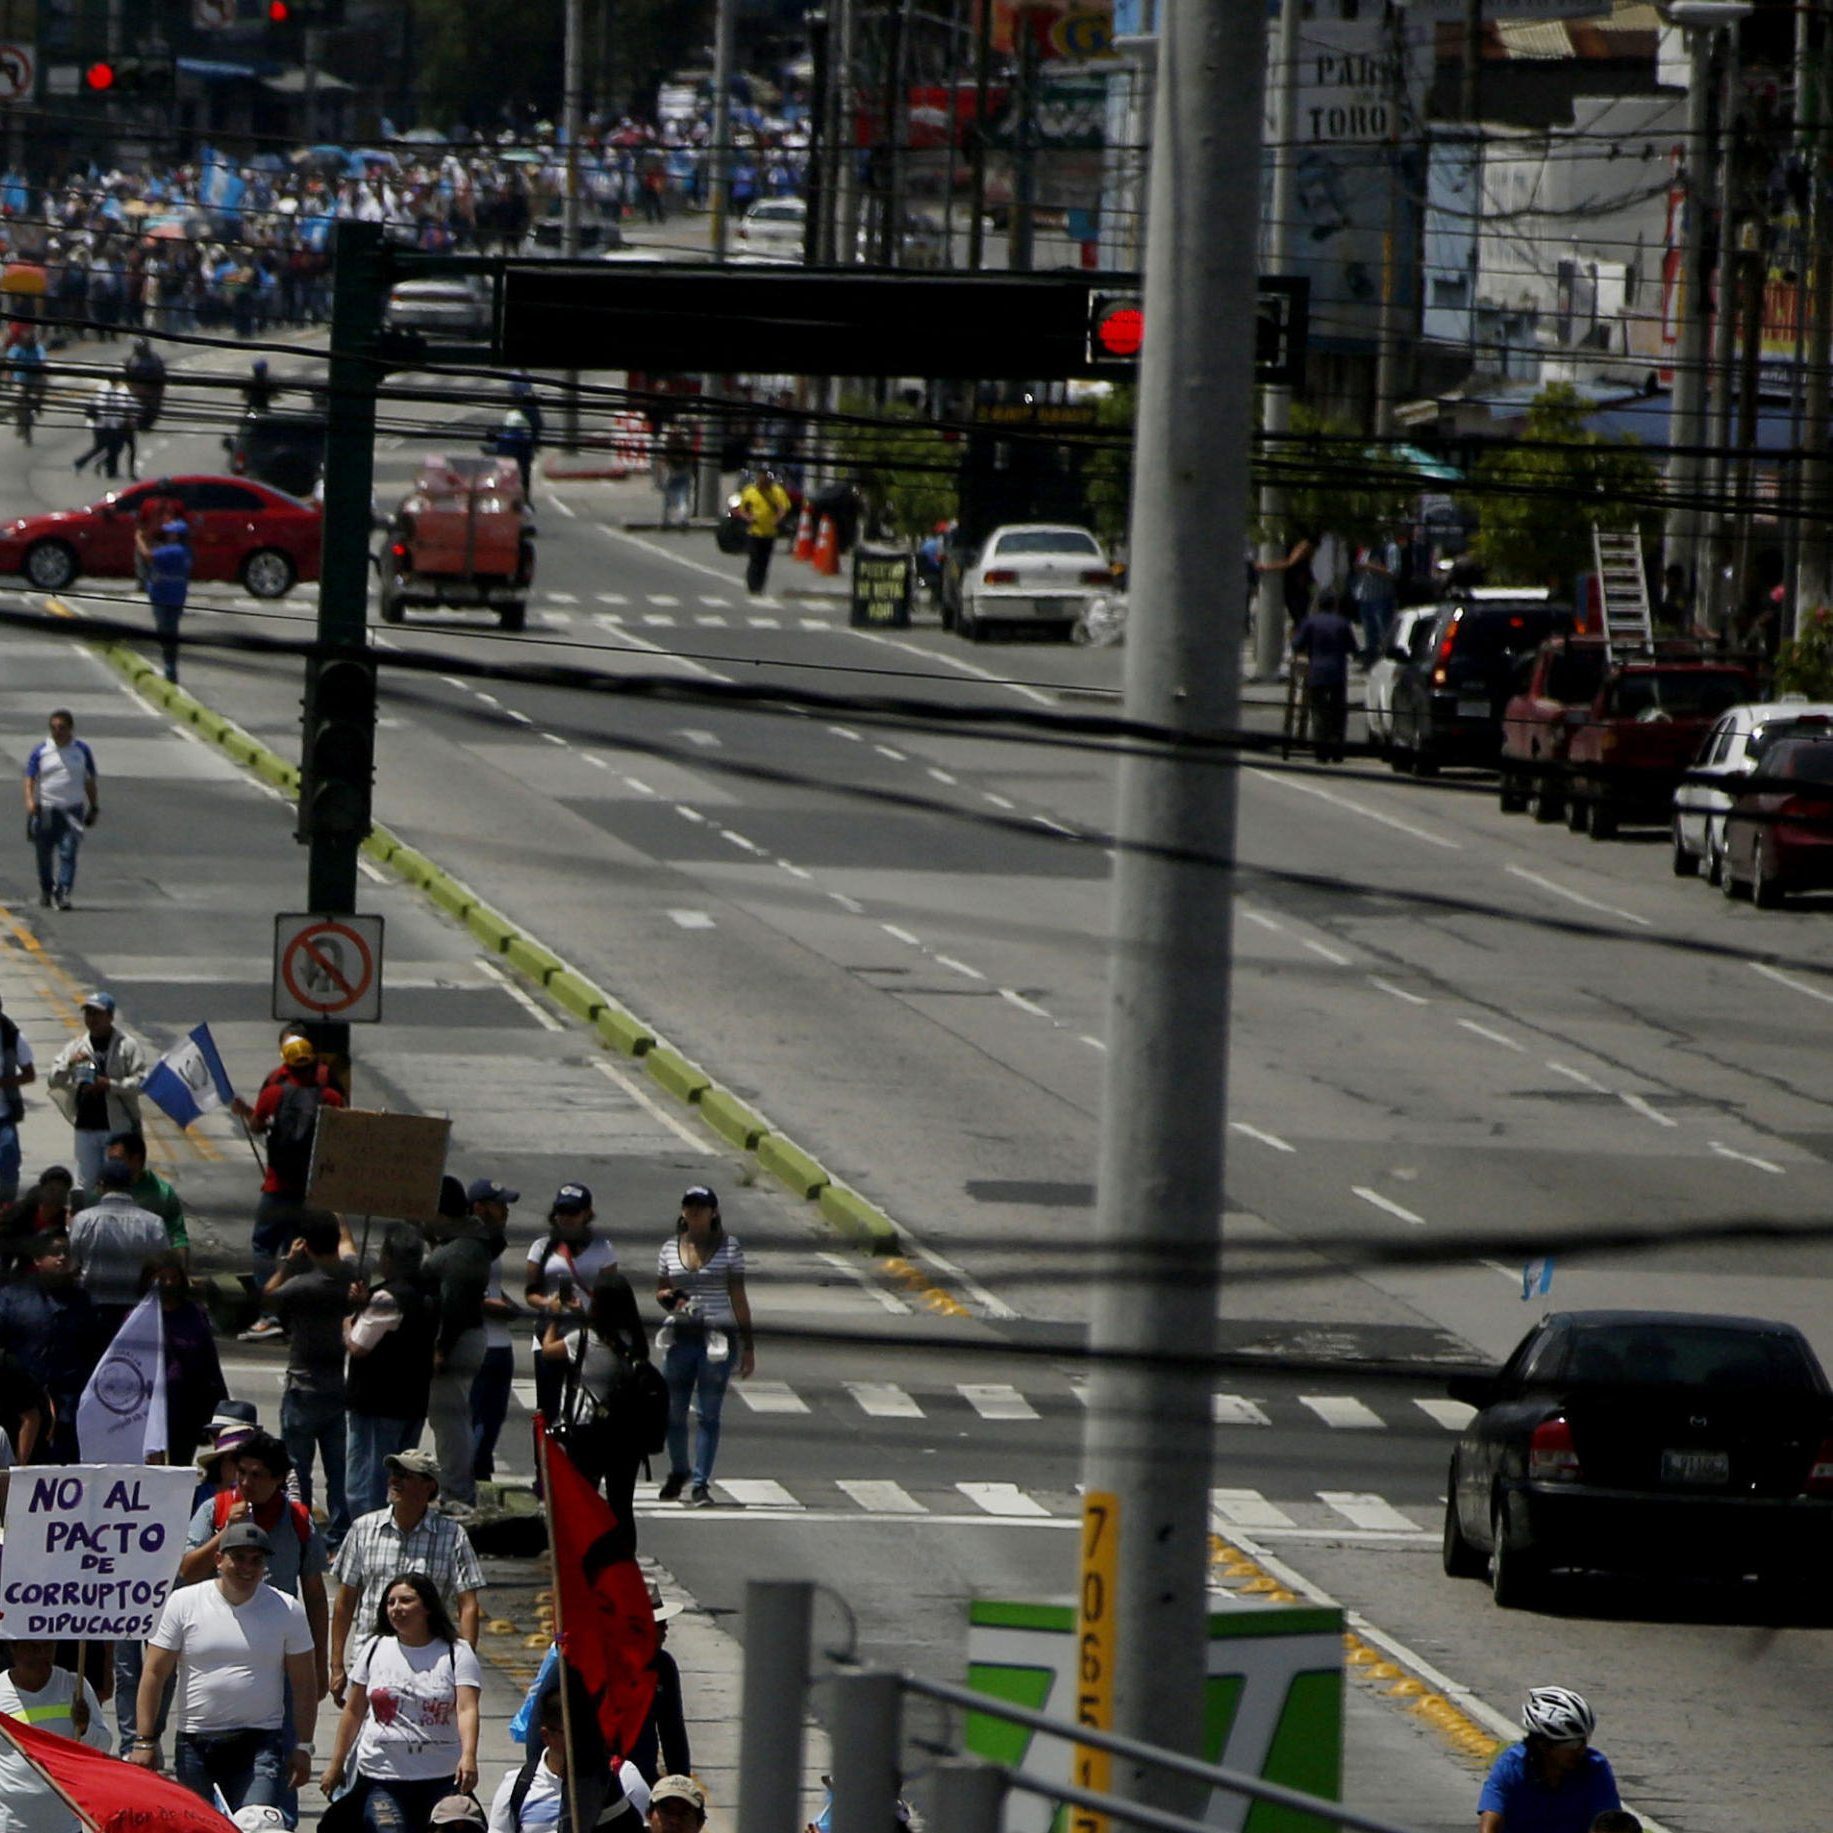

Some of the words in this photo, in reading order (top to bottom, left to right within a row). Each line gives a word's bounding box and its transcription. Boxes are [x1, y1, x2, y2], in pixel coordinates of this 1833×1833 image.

[29, 1477, 83, 1513] NO
[103, 1480, 150, 1513] AL
[46, 1521, 166, 1554] PACTO
[81, 1554, 116, 1574] DE
[5, 1579, 169, 1611] CORRUPTOS
[28, 1612, 154, 1635] DIPUCACOS
